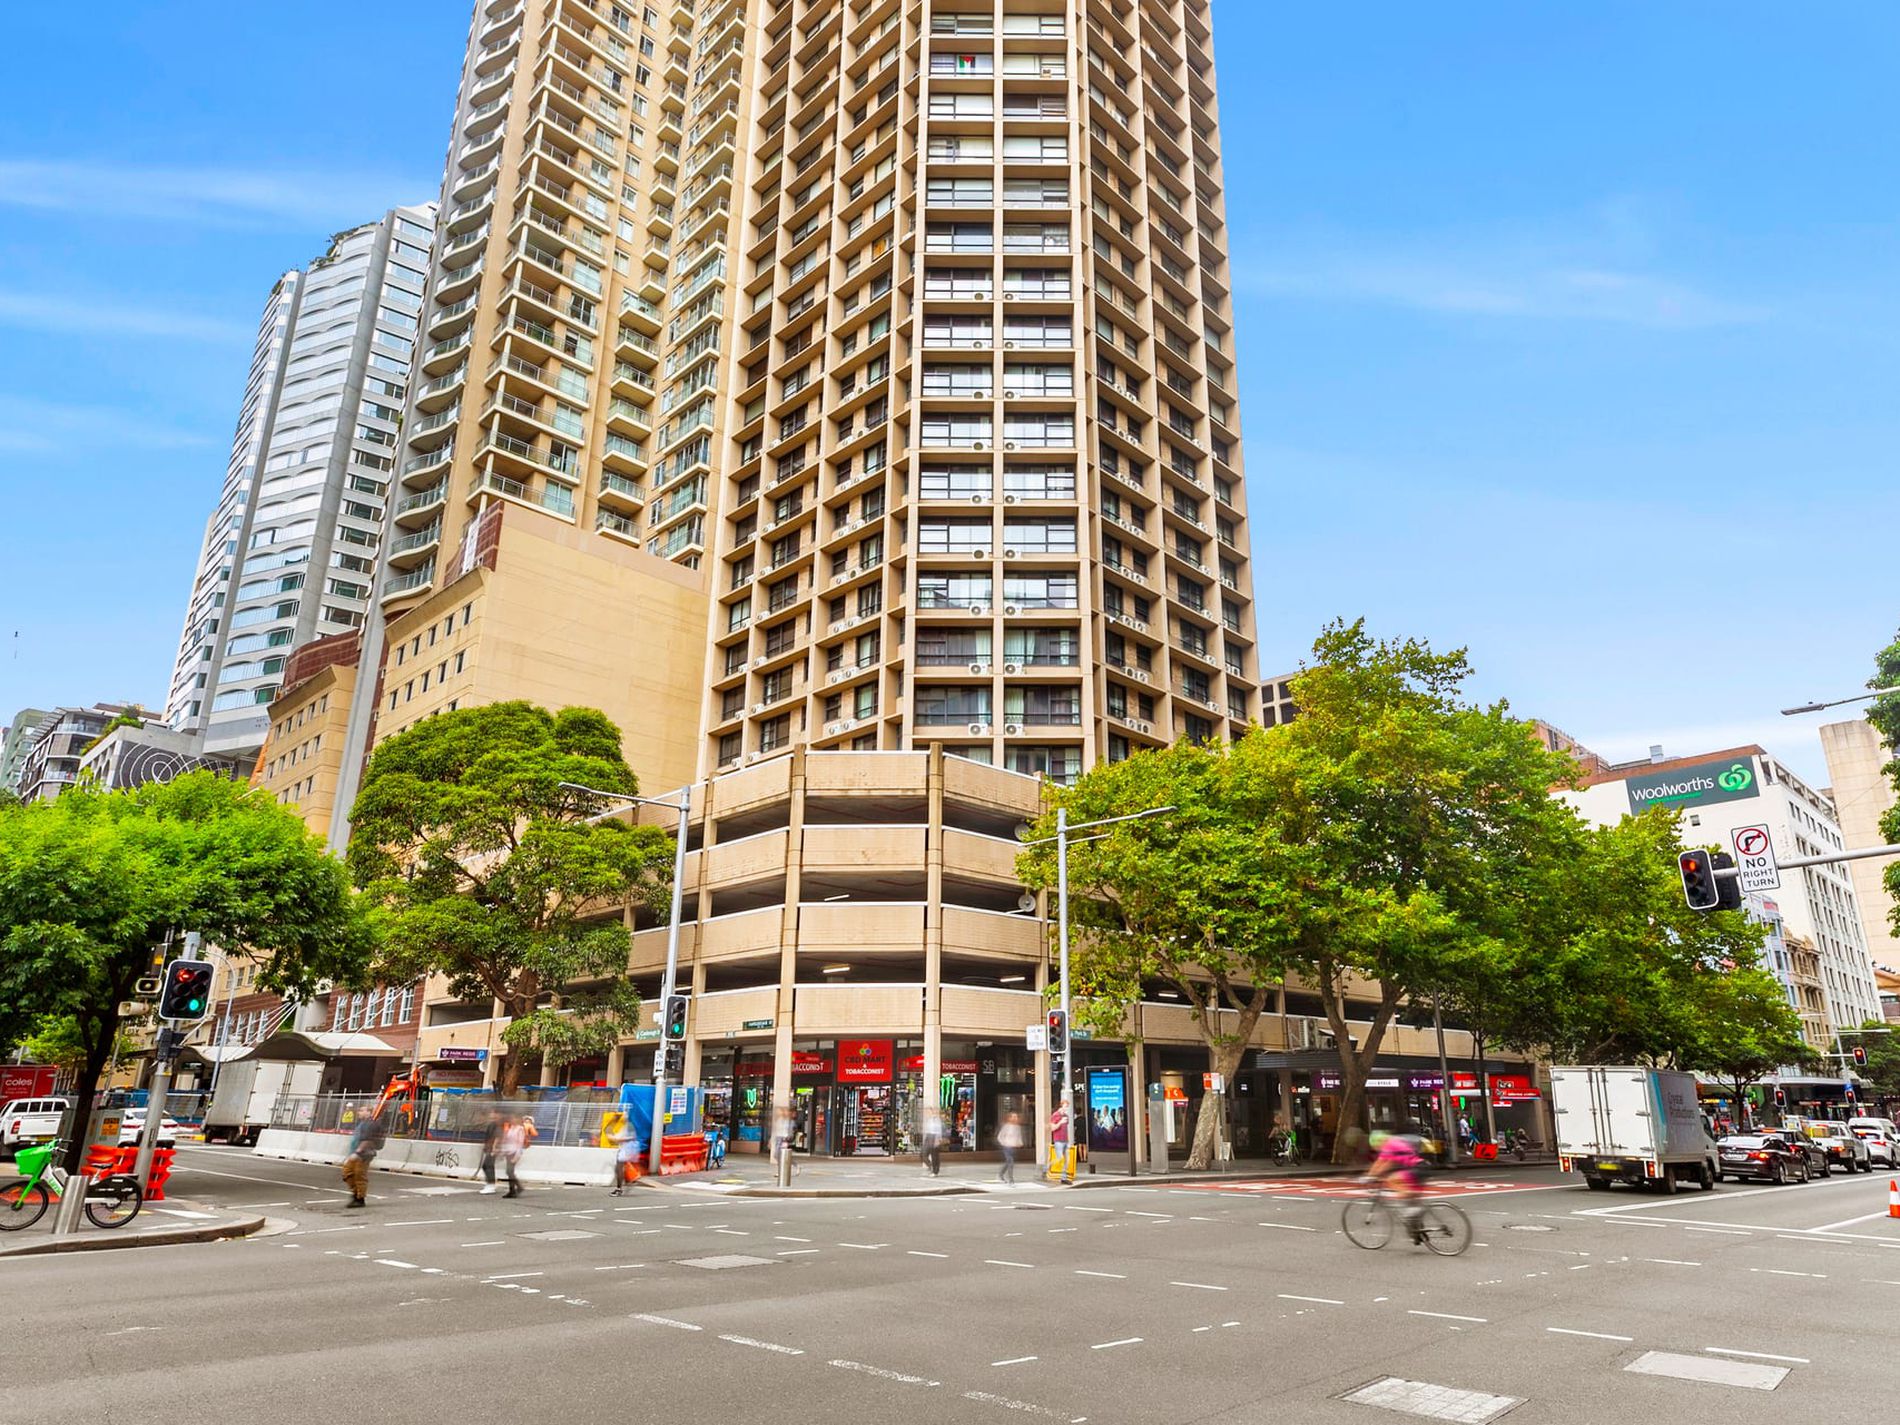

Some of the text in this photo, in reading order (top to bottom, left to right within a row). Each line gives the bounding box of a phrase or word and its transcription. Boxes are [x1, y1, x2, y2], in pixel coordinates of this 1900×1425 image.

[1632, 777, 1715, 801] Woolworths
[1745, 857, 1767, 869] NO
[1743, 868, 1774, 879] RIGHT
[1747, 877, 1775, 888] TURN
[845, 1056, 886, 1064] CBD MART
[942, 1062, 976, 1071] TOBACCONIST
[5, 1078, 33, 1086] coles
